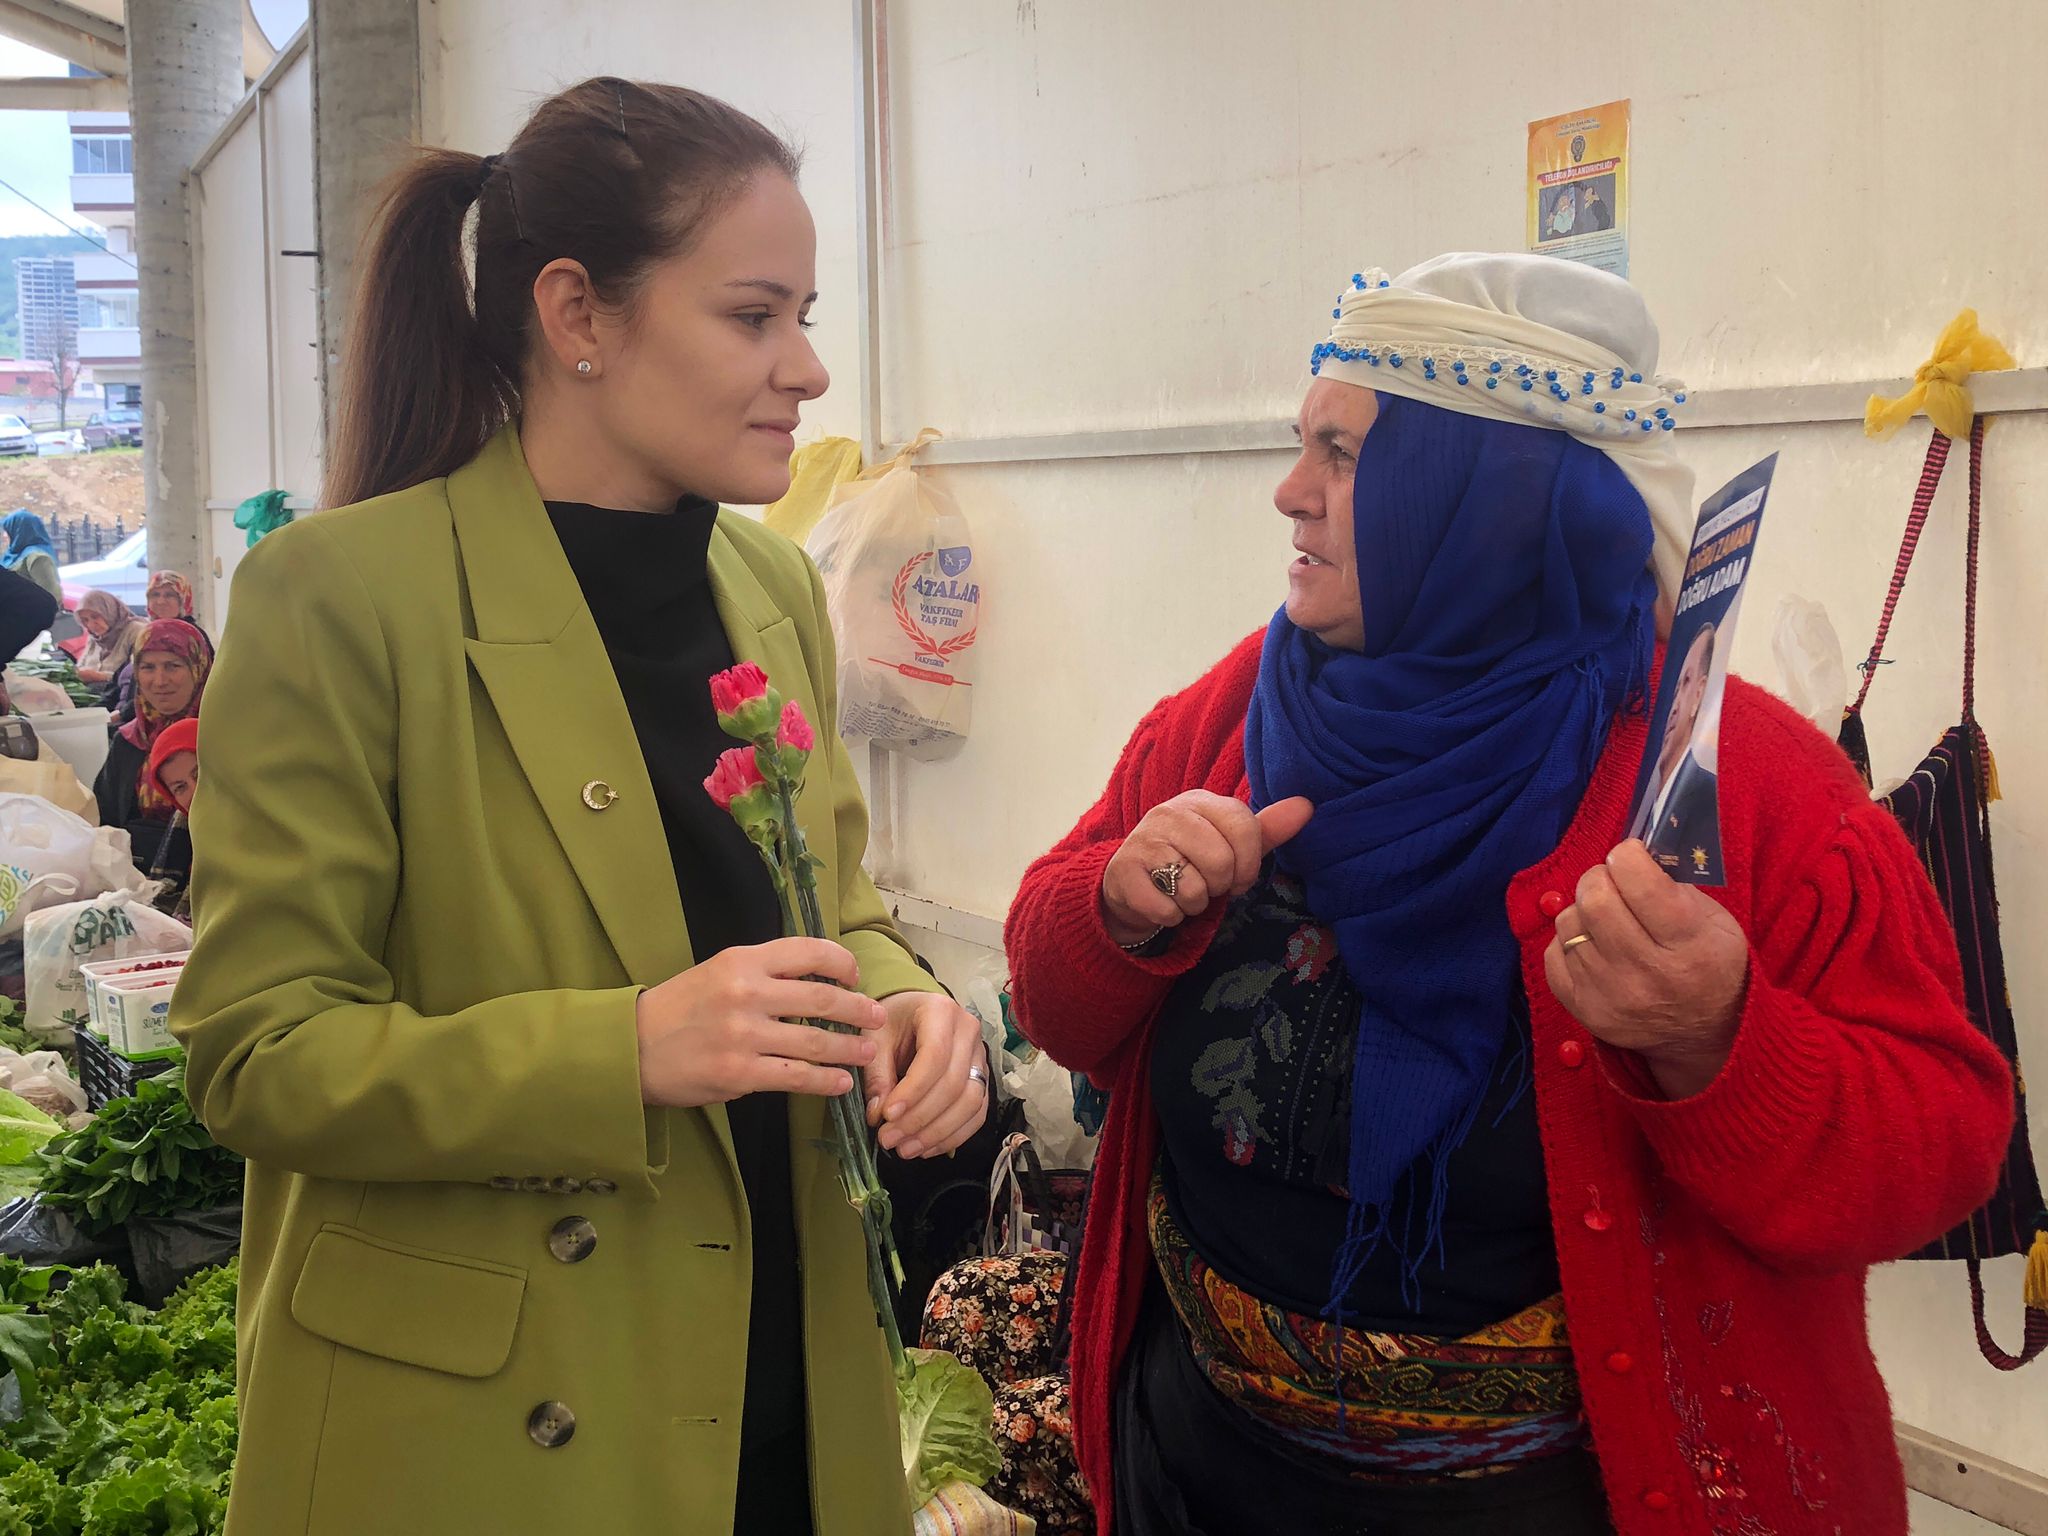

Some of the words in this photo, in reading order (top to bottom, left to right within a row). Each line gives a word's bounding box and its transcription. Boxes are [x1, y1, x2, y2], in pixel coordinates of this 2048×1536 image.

[912, 575, 979, 604] ATALAR
[1677, 574, 1713, 616] DOĞRU
[1707, 557, 1747, 599] ADAM
[921, 614, 937, 626] TAŞ
